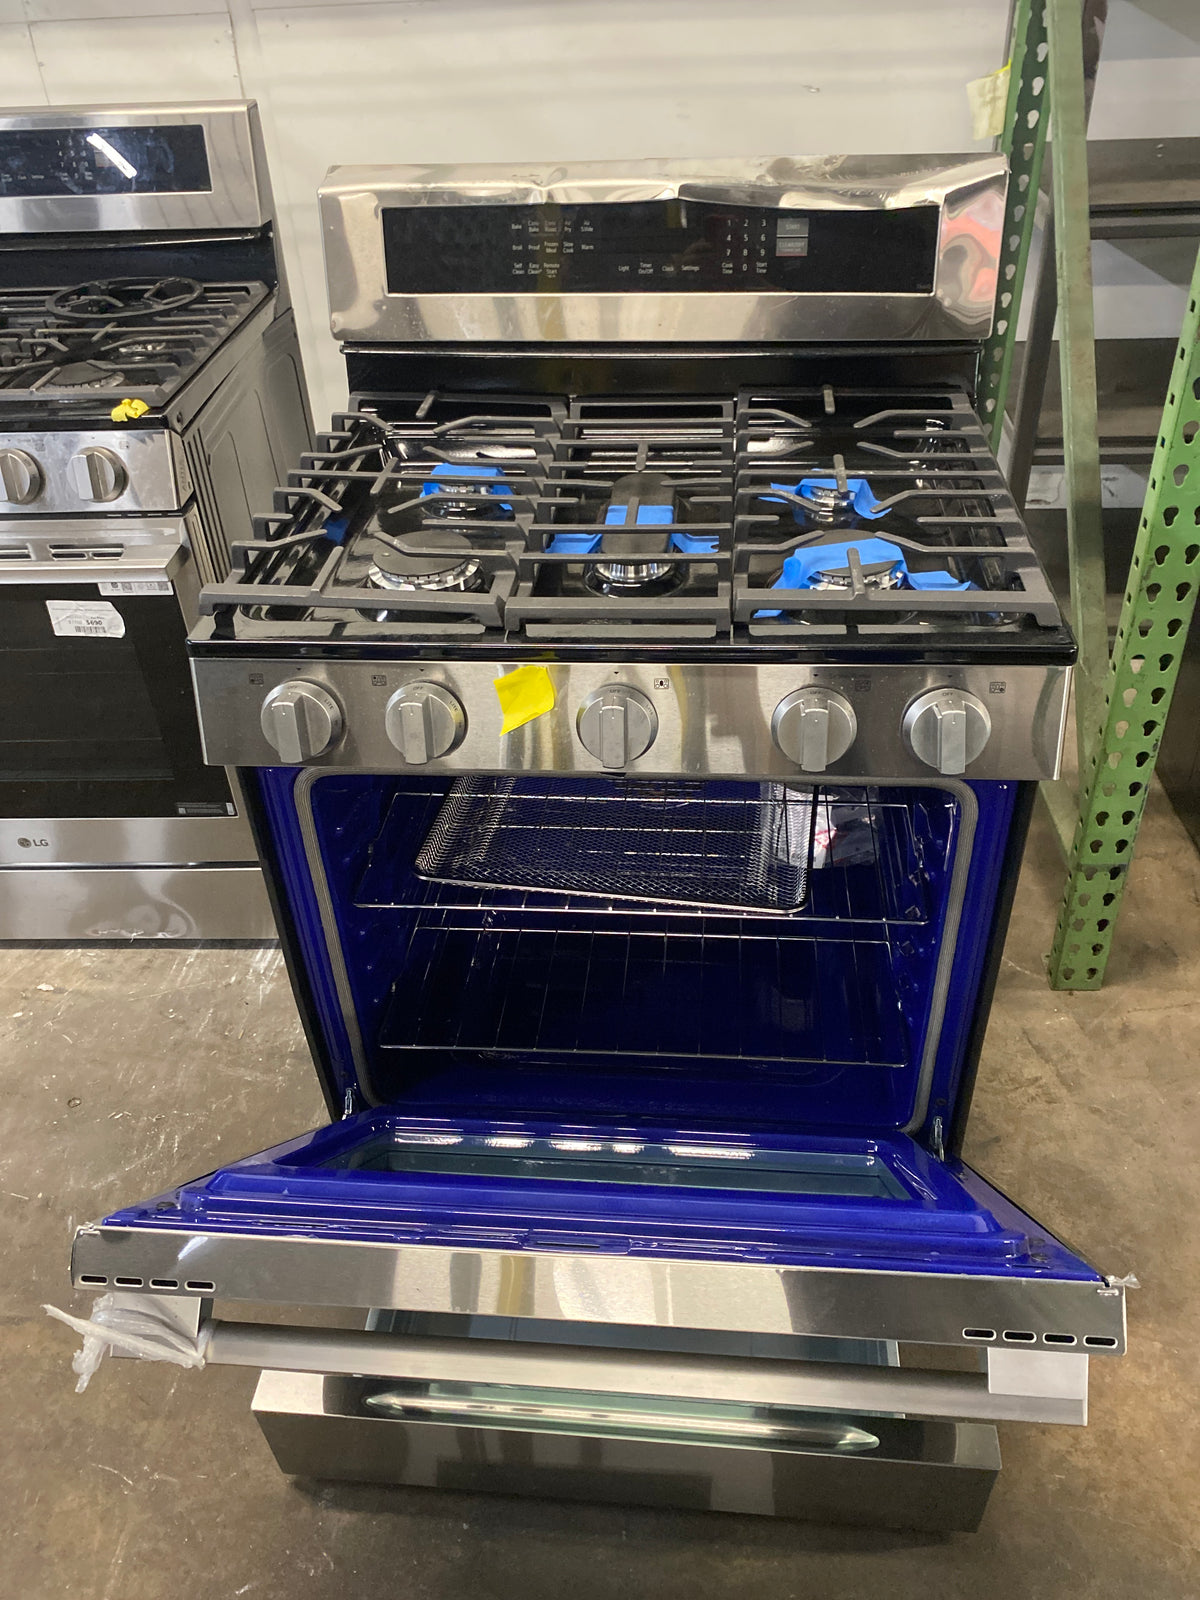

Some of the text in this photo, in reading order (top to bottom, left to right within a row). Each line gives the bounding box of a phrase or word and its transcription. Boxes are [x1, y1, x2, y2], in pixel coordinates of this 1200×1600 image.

[743, 219, 749, 227] 2
[761, 219, 767, 227] 3
[726, 234, 732, 242] 4
[743, 234, 749, 242] 5
[760, 234, 766, 242] 6
[726, 248, 731, 257] 7
[743, 248, 748, 256] 8
[760, 248, 766, 256] 9
[742, 263, 748, 271] 0
[32, 838, 49, 847] LG
